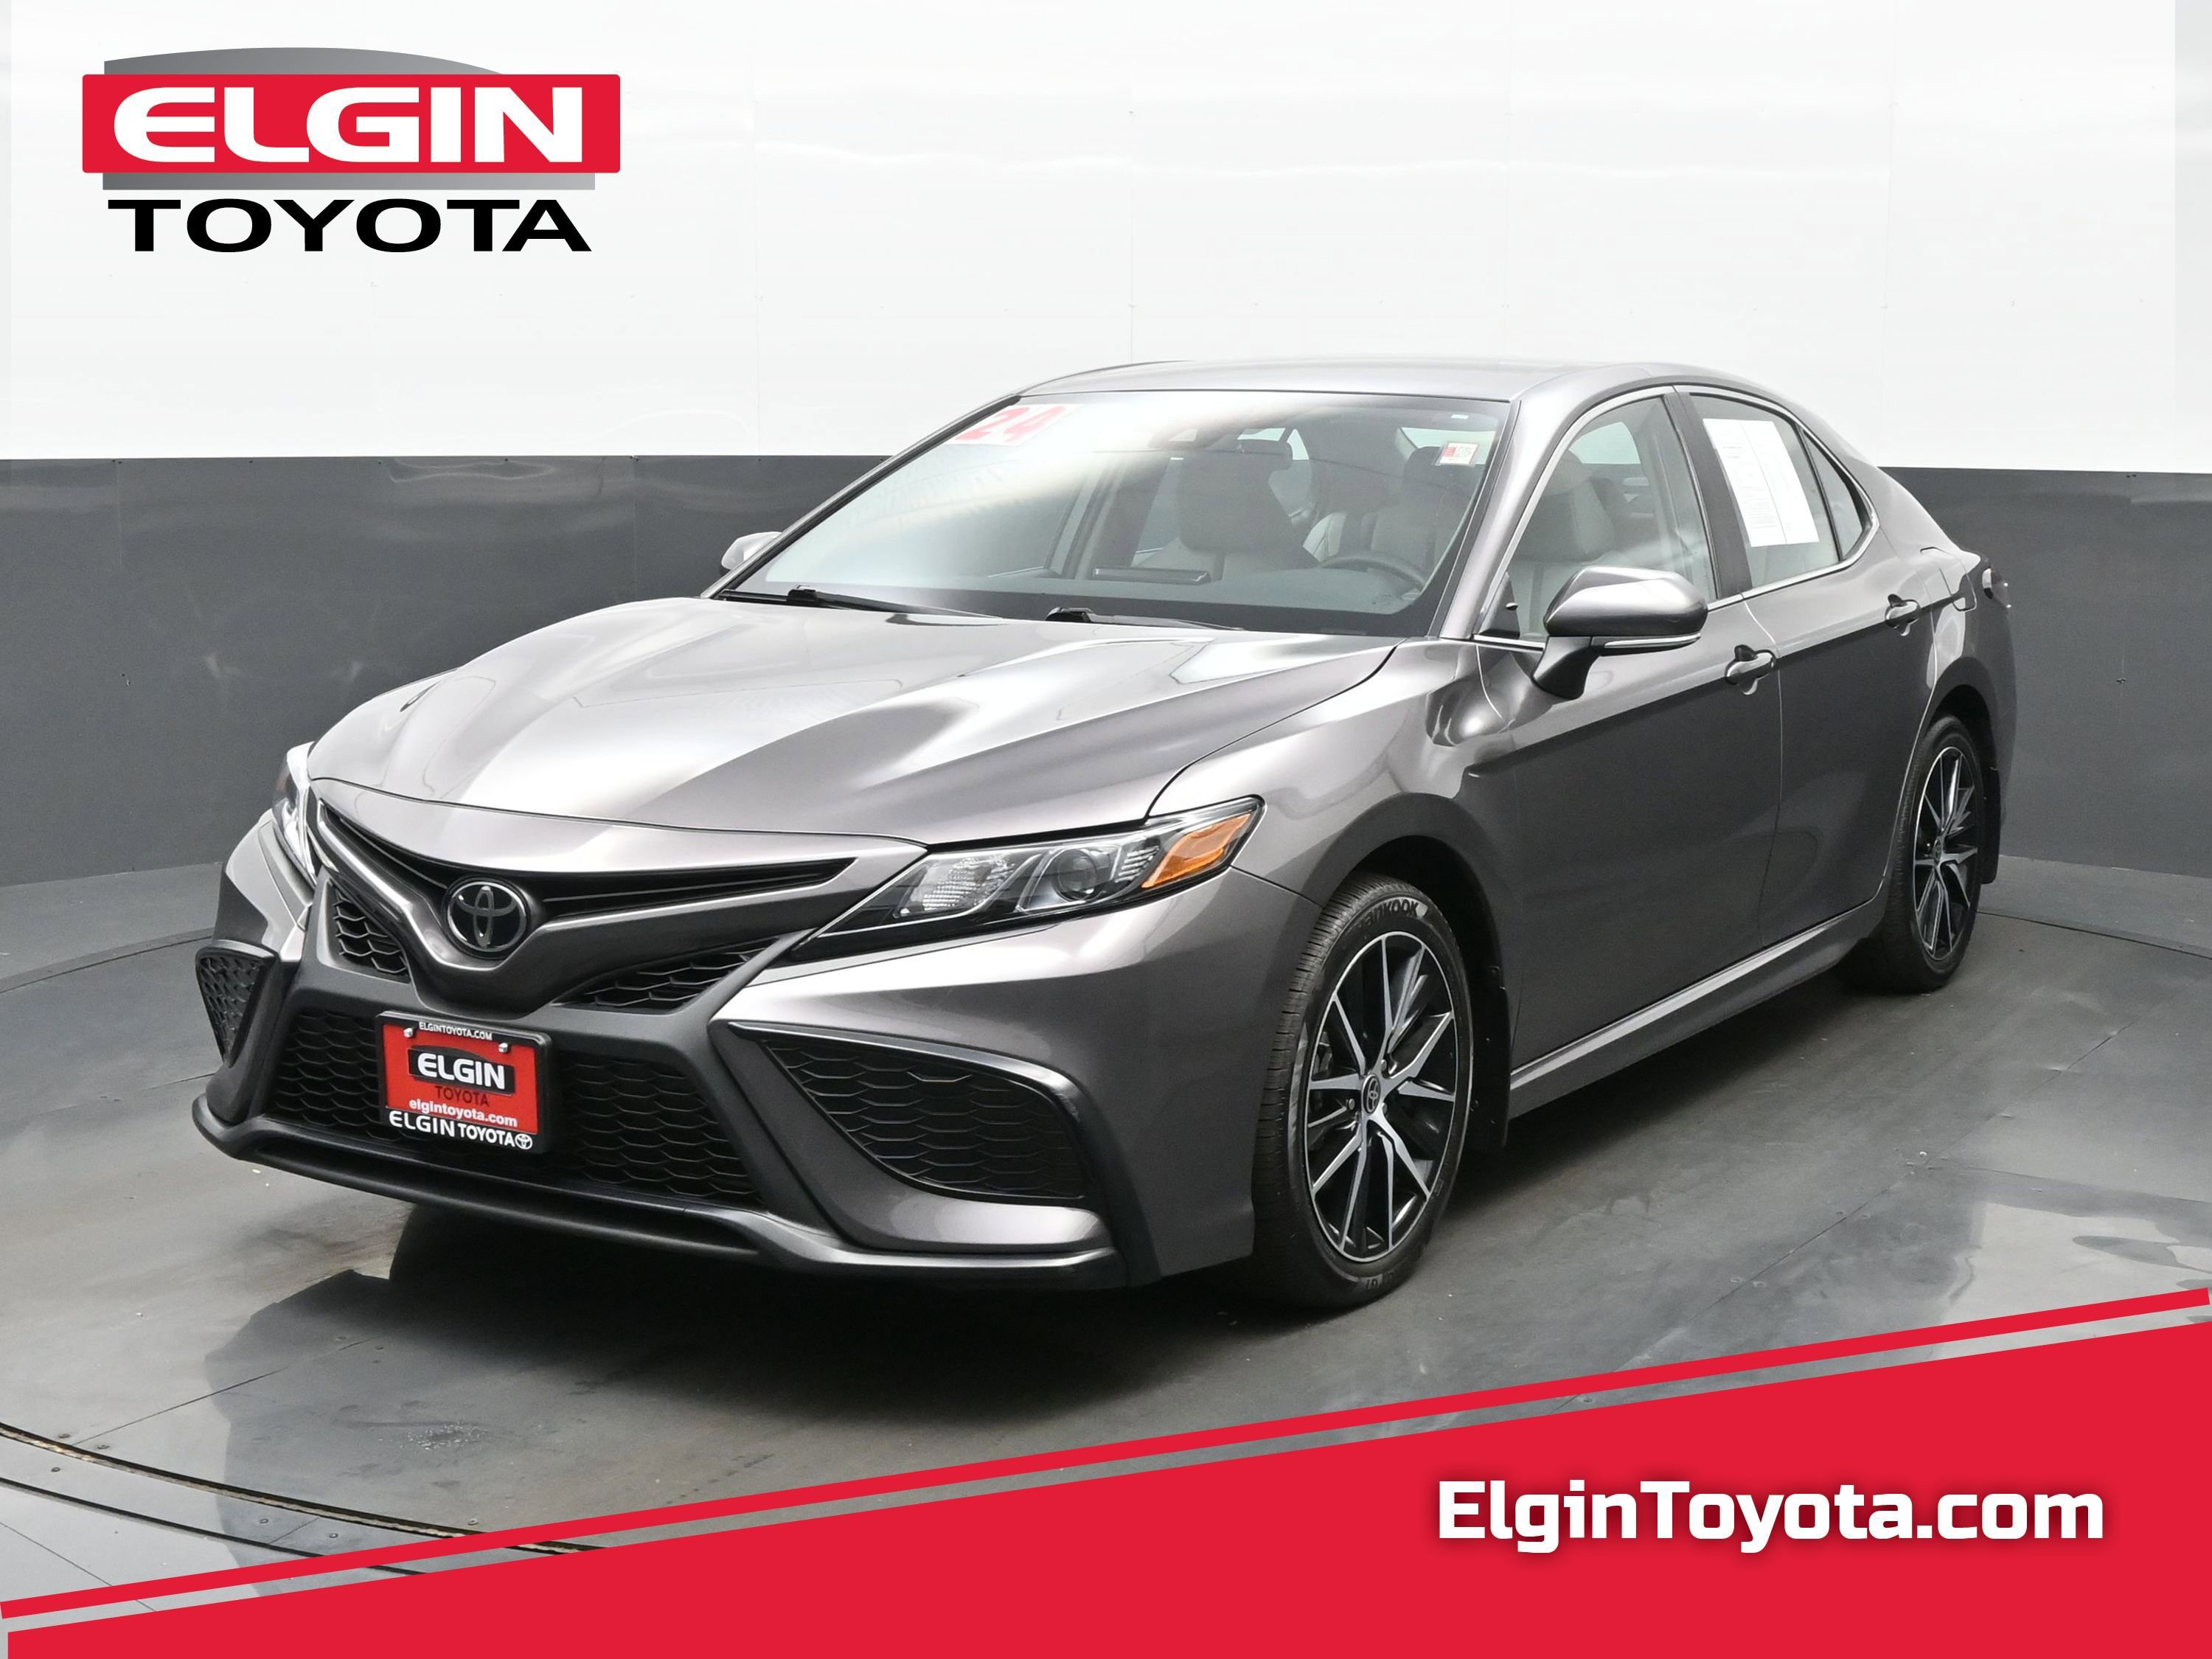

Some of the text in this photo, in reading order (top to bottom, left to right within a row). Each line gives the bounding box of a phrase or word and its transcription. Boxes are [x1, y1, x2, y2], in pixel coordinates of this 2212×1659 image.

[955, 406, 1066, 442] 24
[419, 1021, 493, 1041] ELGINTOYOTA.COM
[417, 1052, 505, 1090] ELGIN
[435, 1085, 490, 1107] TOYOTA
[389, 1110, 515, 1147] ELGIN TOYOTA
[409, 1099, 518, 1127] elgintoyota.com
